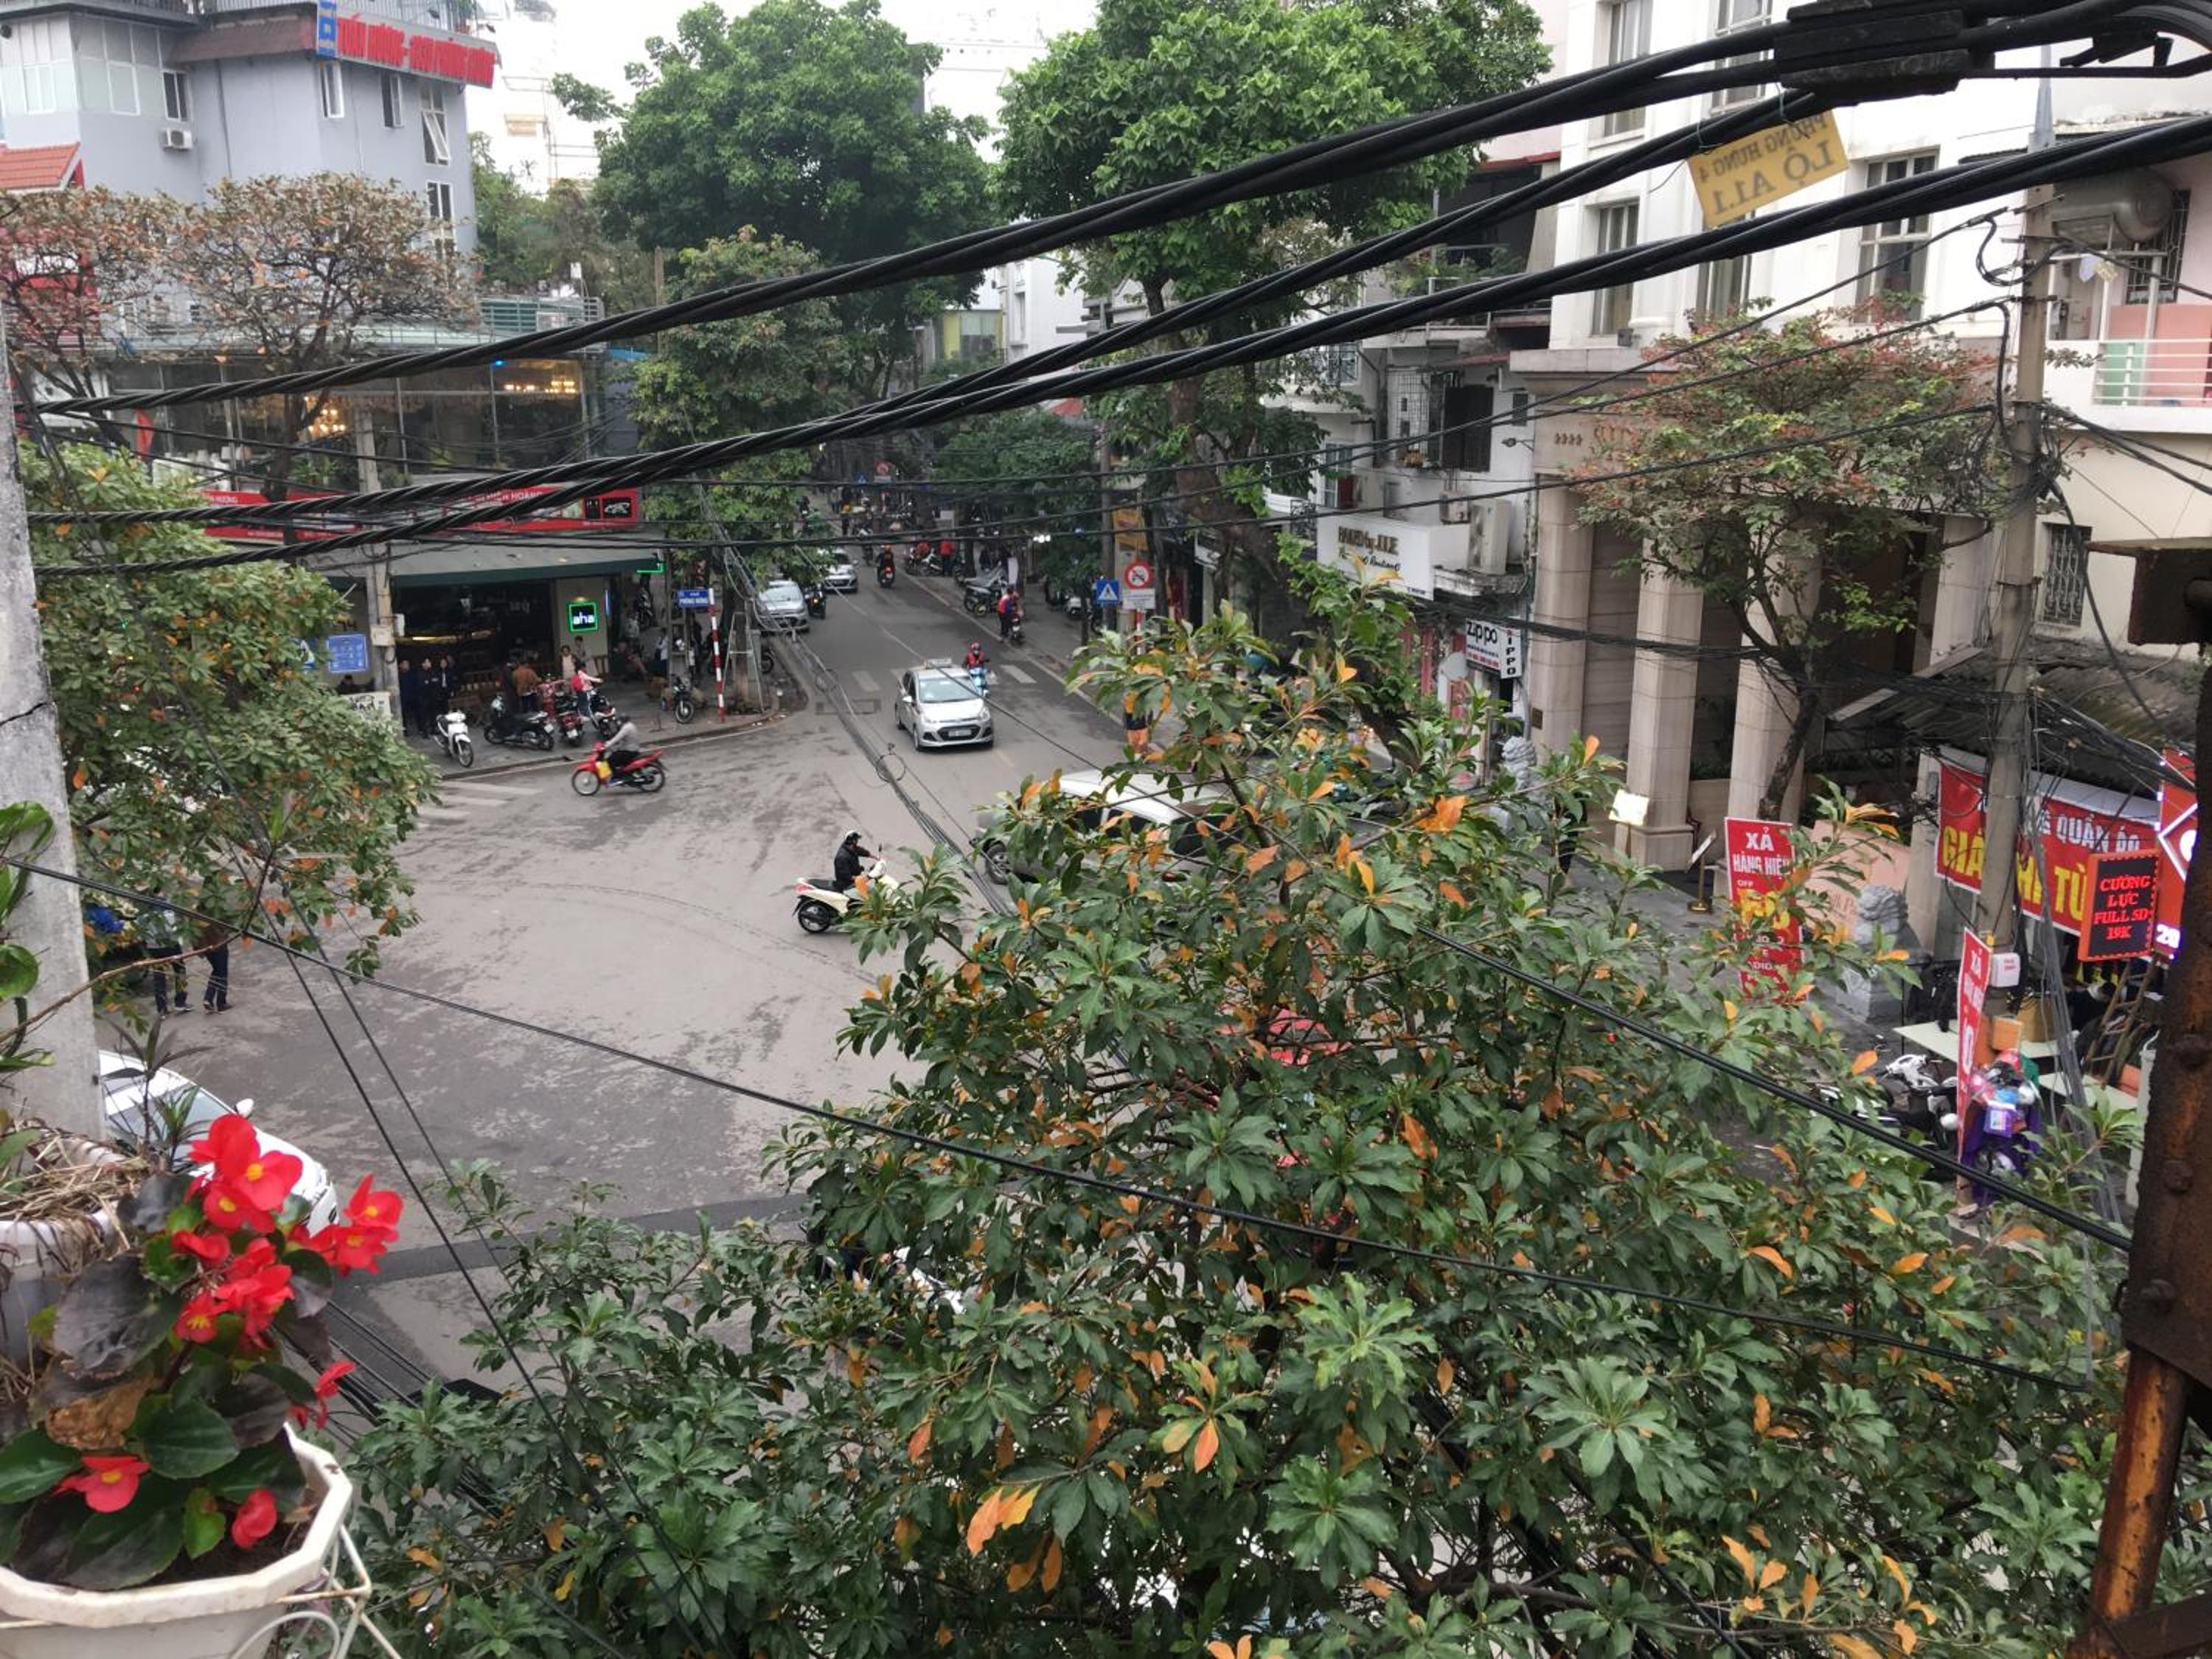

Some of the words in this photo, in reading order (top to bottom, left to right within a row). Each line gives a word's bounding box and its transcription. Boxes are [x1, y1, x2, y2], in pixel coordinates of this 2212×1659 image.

[573, 611, 595, 625] aha
[1746, 827, 1775, 851] XẢ
[1736, 880, 1753, 888] OFF
[2094, 910, 2129, 925] FULL
